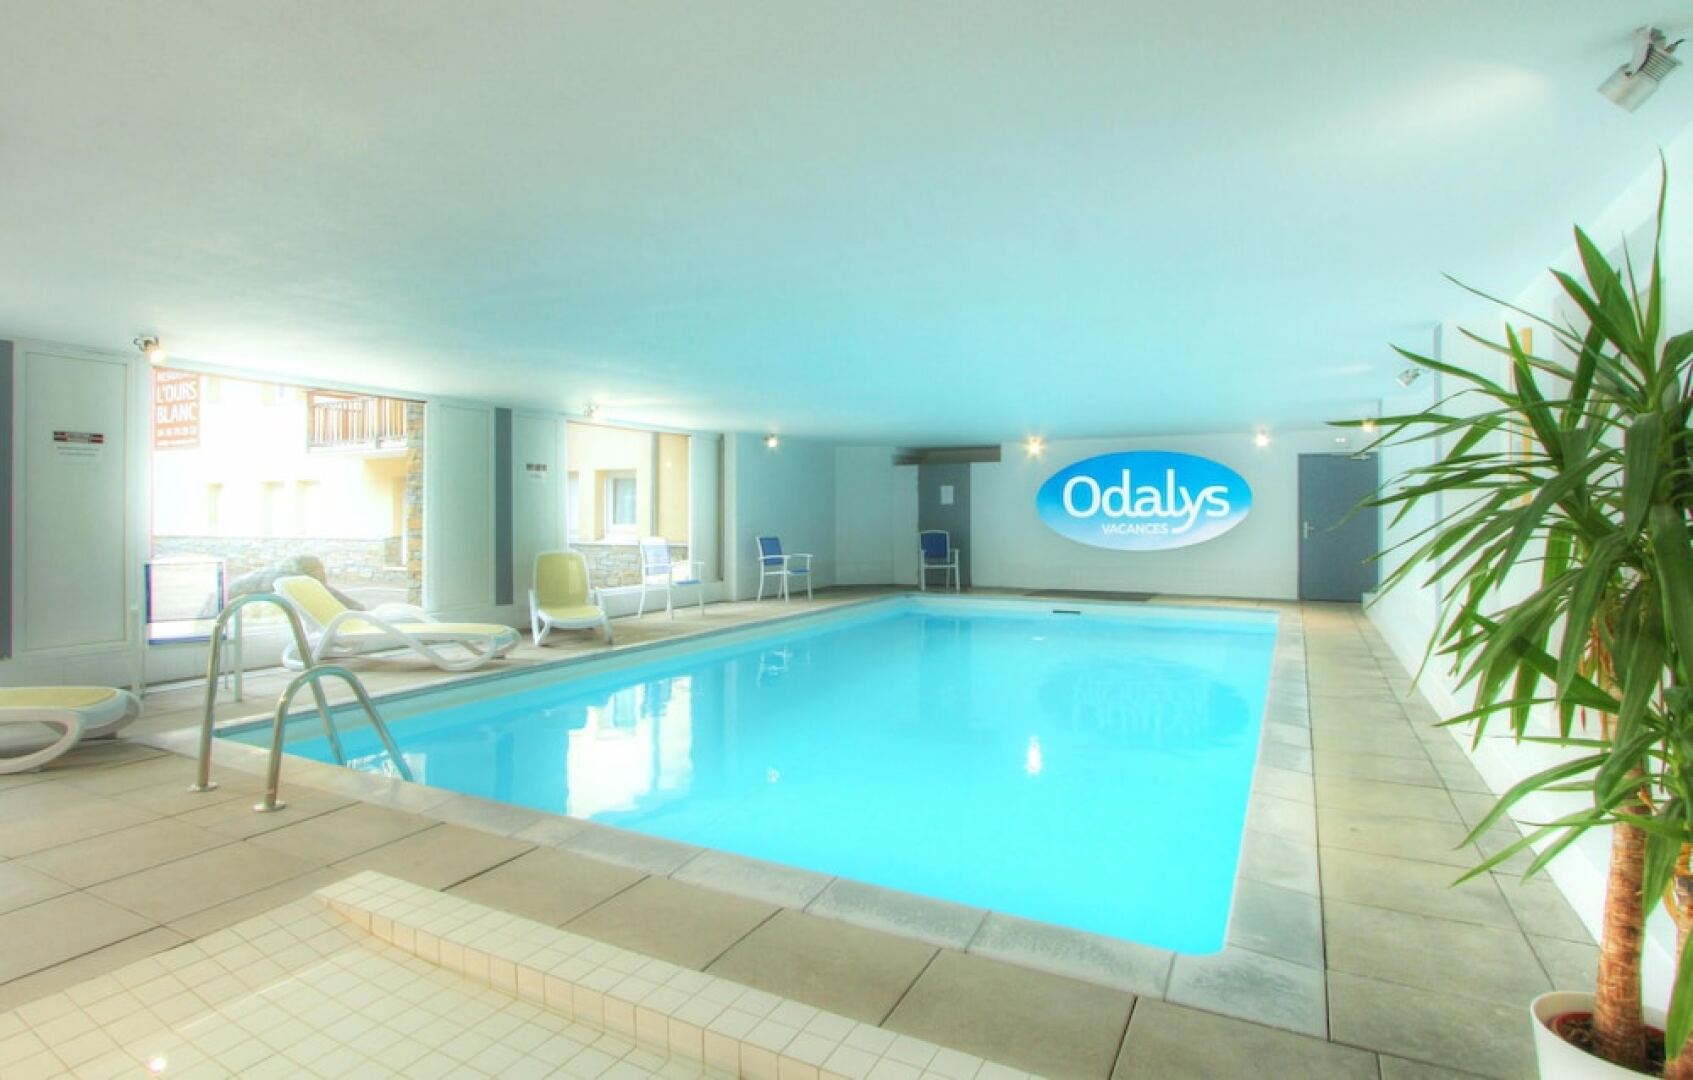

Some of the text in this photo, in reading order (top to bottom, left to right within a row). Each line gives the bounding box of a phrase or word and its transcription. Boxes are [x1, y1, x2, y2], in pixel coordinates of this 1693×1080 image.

[157, 381, 197, 402] L'OURS
[157, 402, 197, 423] BLANC
[1062, 468, 1230, 534] Odalys
[1101, 523, 1168, 535] VACANCES
